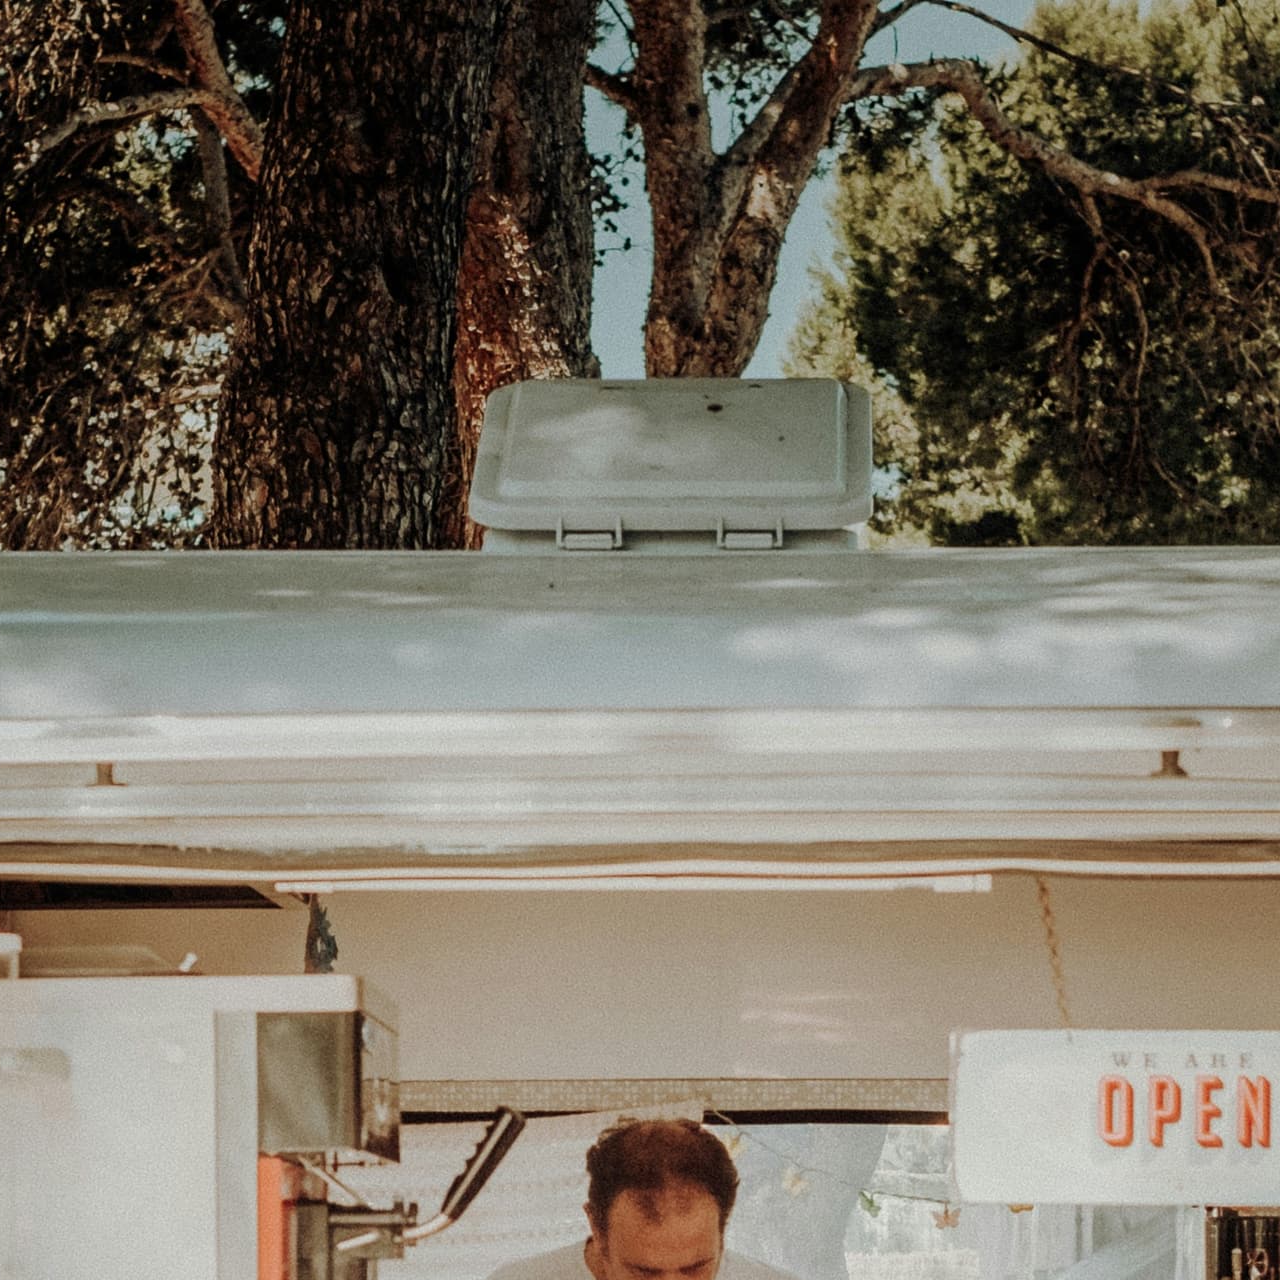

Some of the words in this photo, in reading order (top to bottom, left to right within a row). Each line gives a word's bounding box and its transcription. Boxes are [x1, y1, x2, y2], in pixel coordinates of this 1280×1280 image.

[1112, 1052, 1157, 1069] WE
[1186, 1052, 1252, 1069] ARE
[1097, 1074, 1272, 1149] OPEN
